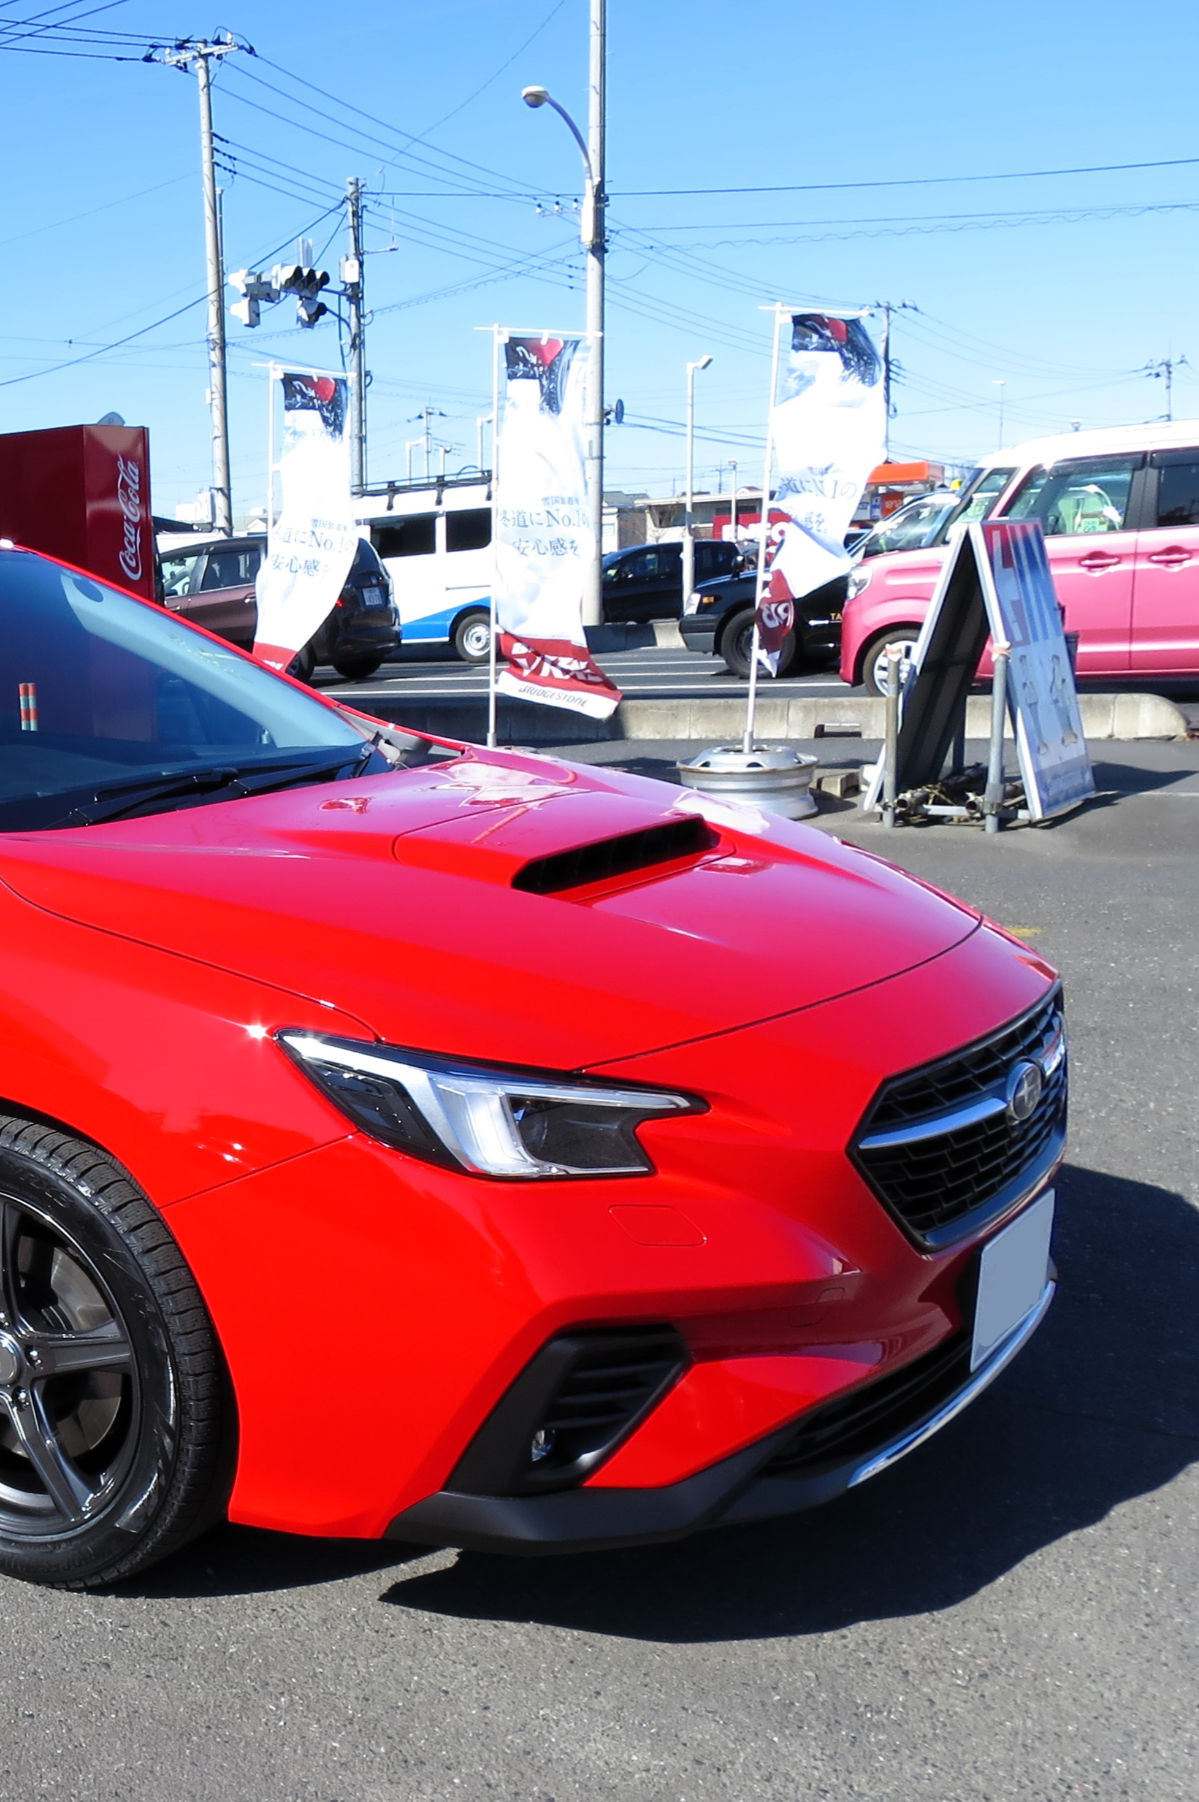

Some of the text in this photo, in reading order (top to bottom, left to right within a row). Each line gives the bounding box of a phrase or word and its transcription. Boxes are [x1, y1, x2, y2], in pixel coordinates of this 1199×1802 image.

[512, 538, 581, 559] 安心感を
[518, 683, 589, 708] BRIDGESTONE
